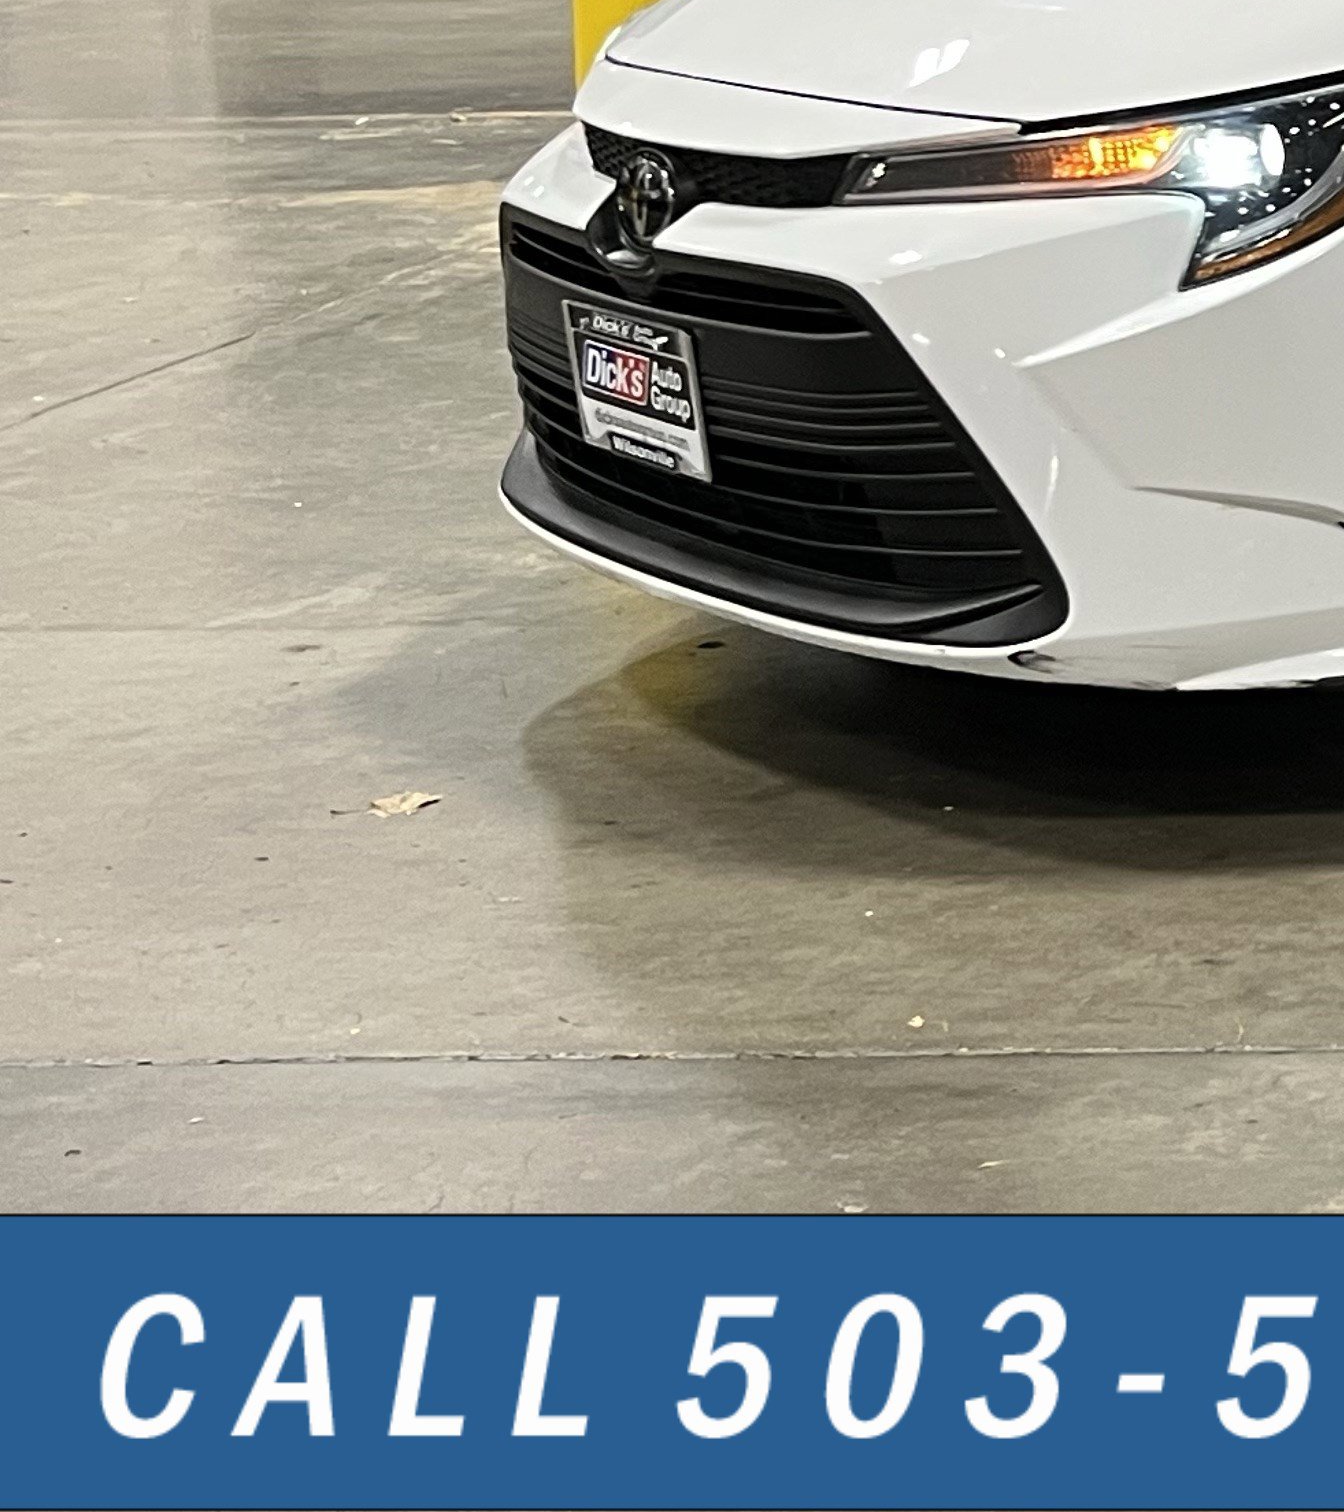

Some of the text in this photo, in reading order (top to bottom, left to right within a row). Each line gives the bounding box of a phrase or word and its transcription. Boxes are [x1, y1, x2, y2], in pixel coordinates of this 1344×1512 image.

[586, 347, 646, 398] Dick's
[651, 361, 683, 392] Auto
[650, 386, 692, 422] Group
